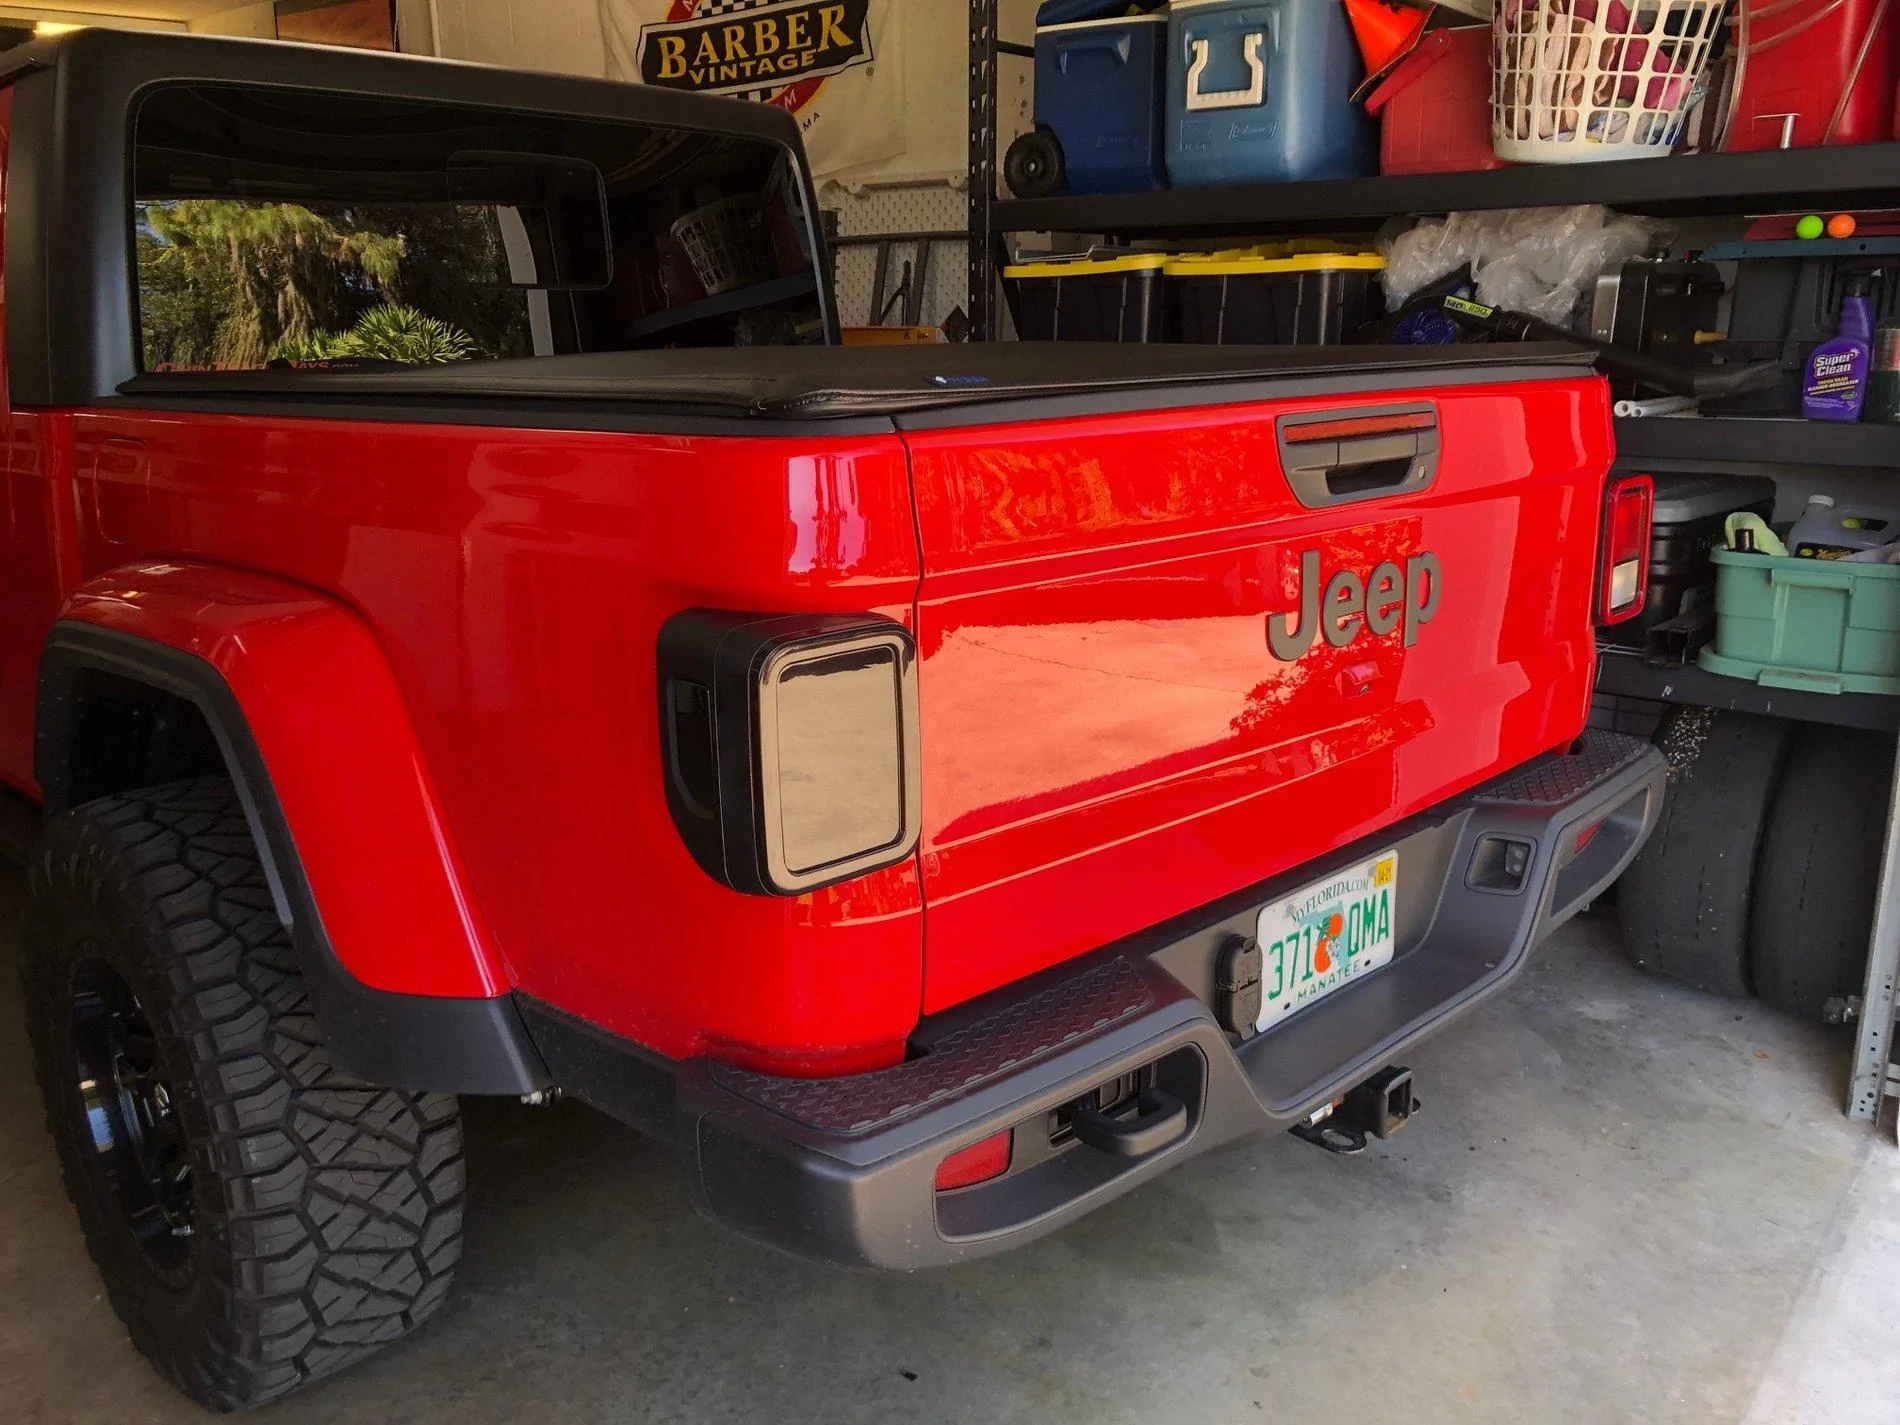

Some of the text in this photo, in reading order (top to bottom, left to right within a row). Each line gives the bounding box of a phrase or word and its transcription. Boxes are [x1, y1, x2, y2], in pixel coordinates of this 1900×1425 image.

[657, 5, 854, 78] BARBER
[689, 51, 815, 84] VINTAGE
[1816, 353, 1855, 367] Super
[1816, 363, 1852, 377] Clean
[1266, 550, 1441, 661] Jeep
[1268, 924, 1314, 1001] 371
[1297, 960, 1360, 1003] MANATEE
